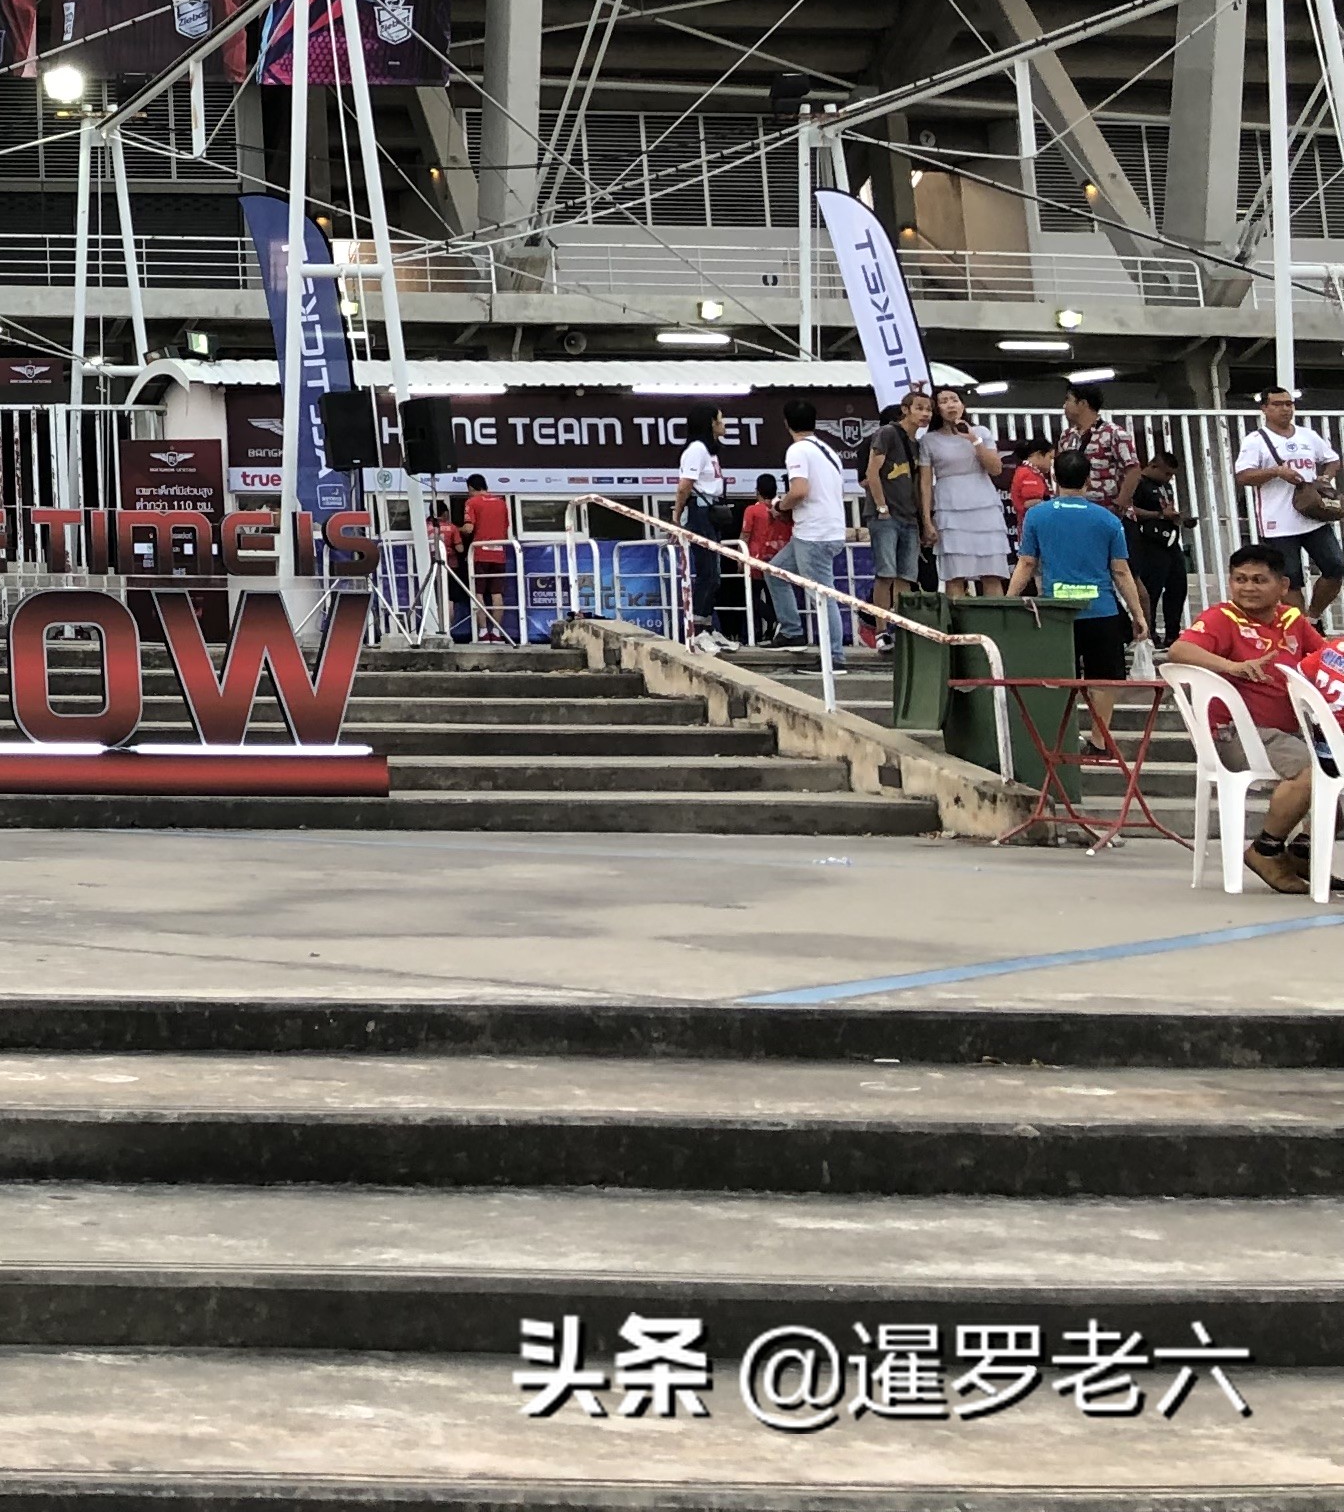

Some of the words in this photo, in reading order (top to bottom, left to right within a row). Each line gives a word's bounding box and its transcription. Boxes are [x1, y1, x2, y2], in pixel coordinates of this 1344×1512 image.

[855, 228, 912, 387] TICKET
[382, 417, 497, 445] HME
[508, 417, 623, 445] TEAM
[633, 417, 764, 445] TICET
[248, 448, 284, 457] BANGK
[241, 471, 281, 487] true
[173, 501, 192, 510] 110
[31, 509, 279, 576] TIME
[292, 511, 381, 577] IS
